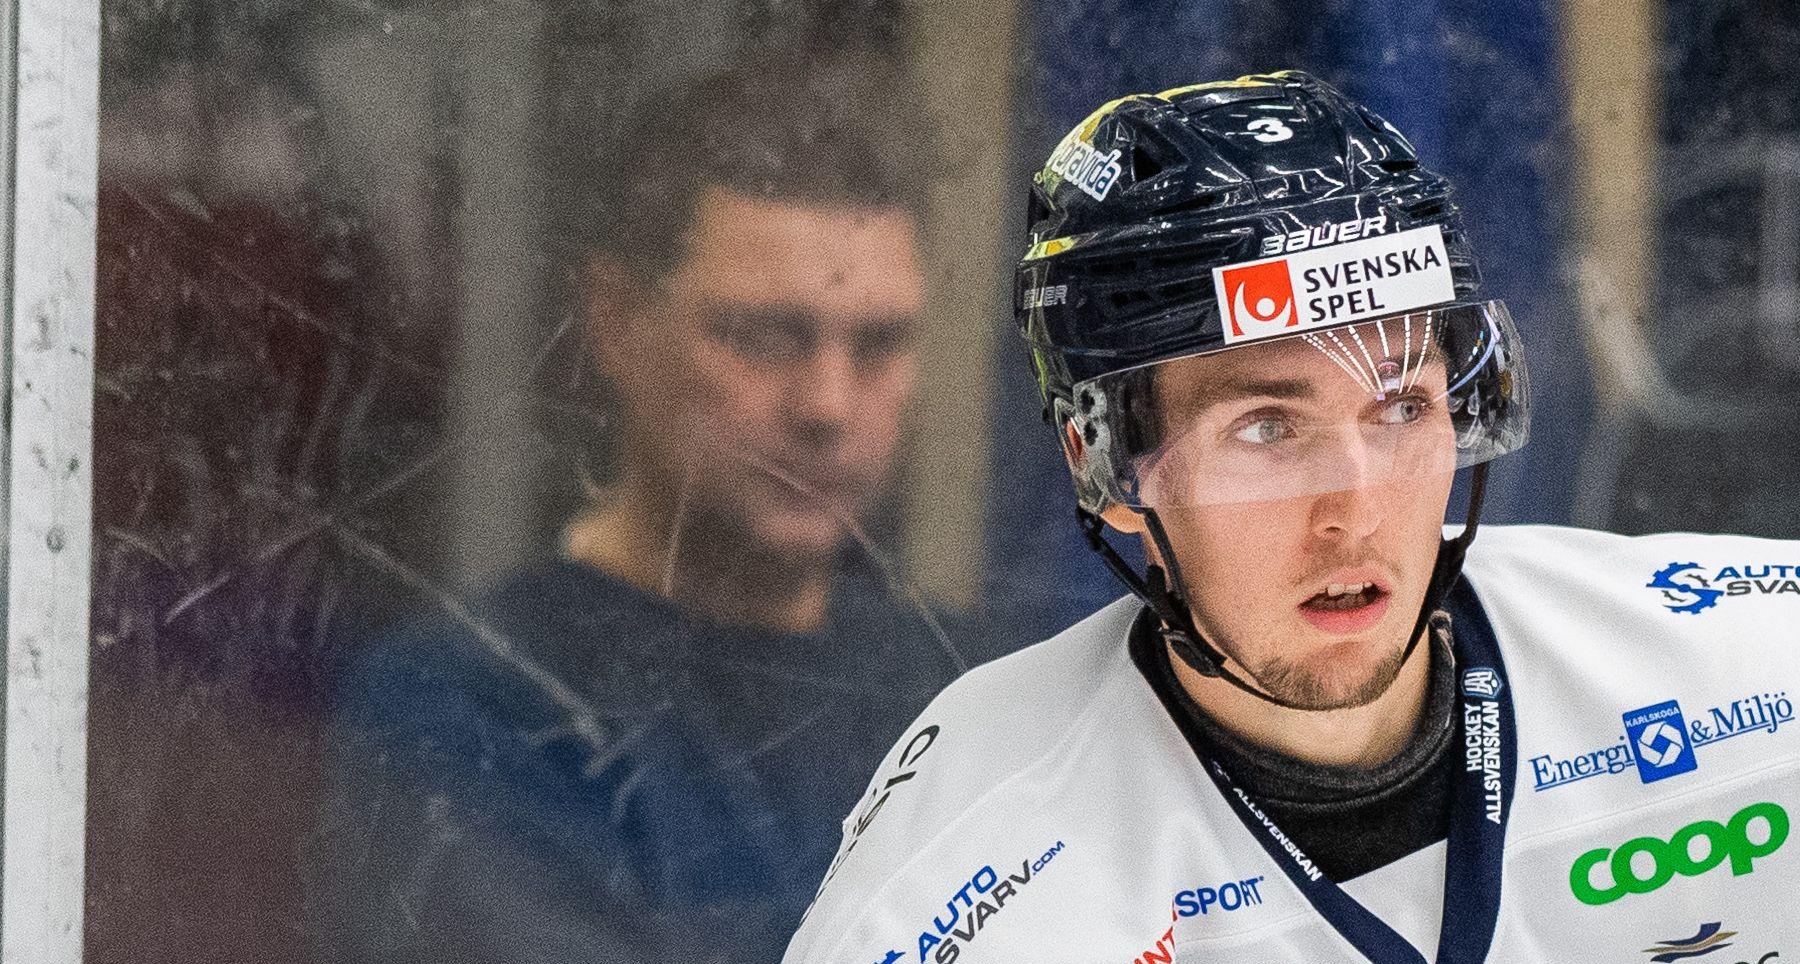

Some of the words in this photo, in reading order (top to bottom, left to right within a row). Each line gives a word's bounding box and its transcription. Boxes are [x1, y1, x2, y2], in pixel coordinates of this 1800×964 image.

[1246, 117, 1292, 144] 3
[1304, 244, 1442, 293] SVENSKA
[1309, 287, 1386, 323] SPEL
[1465, 703, 1482, 772] HOCKEY
[1626, 706, 1680, 728] KARLSKOGA
[1483, 701, 1502, 825] ALLSVENSKAN
[1529, 735, 1634, 789] Energi
[1233, 787, 1323, 882] ALLSVENSKAN
[1569, 802, 1790, 906] coop
[918, 865, 998, 964] AUTO
